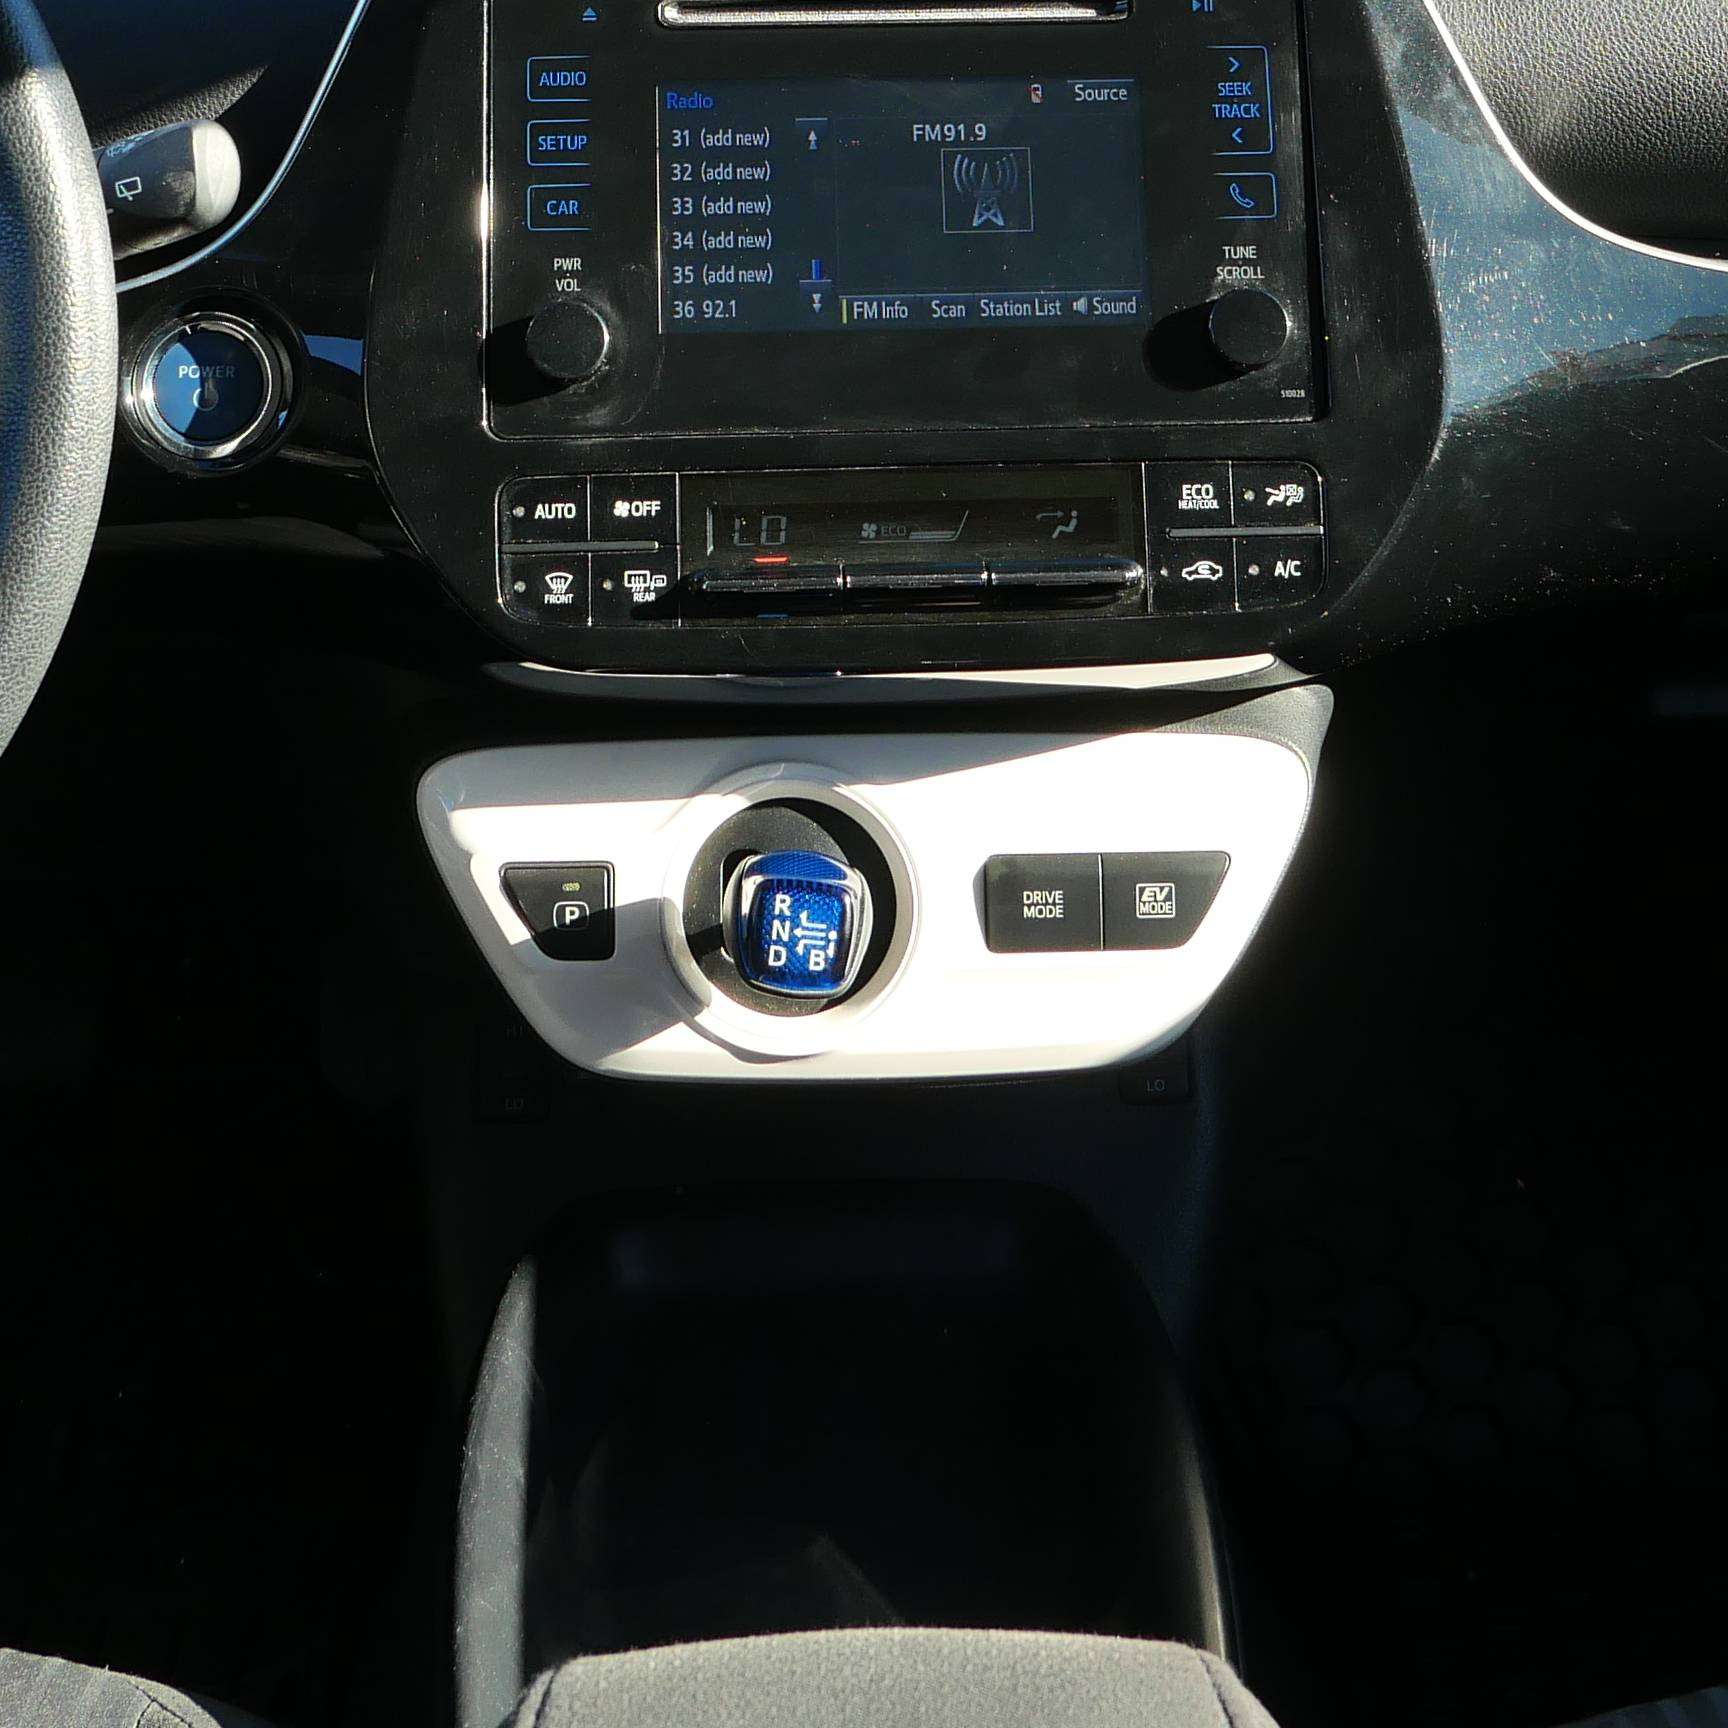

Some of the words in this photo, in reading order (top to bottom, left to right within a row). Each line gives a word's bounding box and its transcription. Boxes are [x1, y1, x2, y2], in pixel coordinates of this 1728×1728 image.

[539, 71, 587, 87] AUDIO
[1074, 84, 1129, 102] Source
[1217, 82, 1252, 97] SEEK
[666, 92, 713, 110] Radio
[1212, 103, 1261, 119] TRACK
[537, 134, 588, 152] SETUP
[671, 130, 691, 148] 31
[700, 128, 733, 148] (add
[735, 128, 771, 148] new)
[671, 164, 692, 182] 32
[701, 162, 734, 183] (add
[736, 162, 771, 183] new)
[546, 199, 579, 216] CAR
[671, 198, 693, 216] 33
[701, 196, 734, 217] (add
[737, 196, 772, 217] new)
[672, 232, 694, 250] 34
[702, 230, 735, 251] (add
[737, 230, 773, 251] new)
[1221, 245, 1257, 260] TUNE
[553, 257, 582, 271] PWR
[1215, 265, 1265, 280] SCROLL
[672, 266, 694, 285] 35
[702, 265, 735, 286] (add
[738, 265, 773, 286] new)
[555, 278, 582, 292] VOL
[672, 300, 695, 319] 36
[702, 300, 737, 319] 92.1
[853, 300, 879, 319] FM
[882, 300, 909, 319] Info
[931, 300, 966, 319] Scan
[979, 298, 1032, 318] Station
[1034, 298, 1062, 318] List
[1092, 296, 1138, 315] Sound
[178, 364, 235, 379] POWER
[1181, 484, 1214, 501] ECO
[534, 502, 576, 521] AUTO
[630, 500, 661, 518] OFF
[1178, 500, 1220, 510] HEAT/COOL
[880, 524, 907, 538] ECO
[1274, 559, 1301, 578] A/C
[544, 593, 574, 605] FRONT
[633, 591, 657, 603] REAR
[1022, 890, 1064, 904] DRIVE
[1140, 887, 1170, 902] EV
[774, 893, 792, 917] R
[1022, 905, 1065, 919] MODE
[1139, 901, 1173, 914] MODE
[563, 905, 580, 927] P
[771, 919, 791, 942] N
[768, 944, 787, 968] D
[808, 948, 827, 972] B
